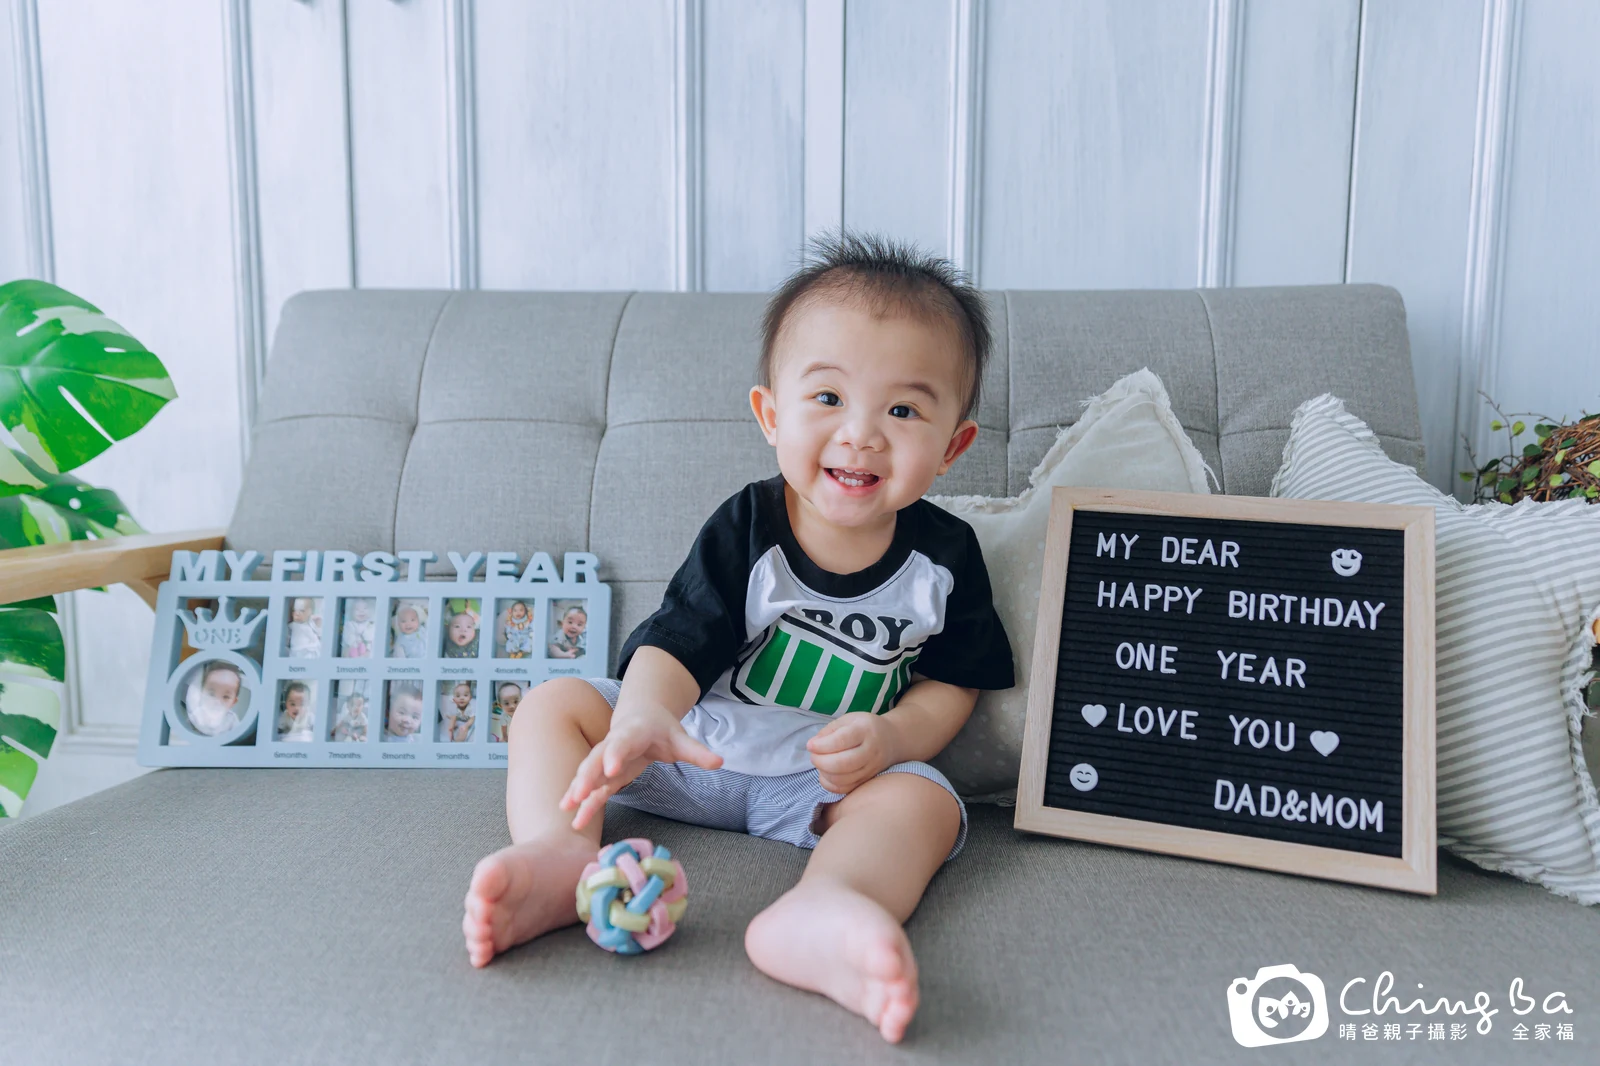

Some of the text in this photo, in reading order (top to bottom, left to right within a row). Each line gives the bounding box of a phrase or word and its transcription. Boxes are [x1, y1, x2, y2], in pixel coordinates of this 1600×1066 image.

[168, 549, 600, 583] MY FIRST YEAR
[1096, 532, 1241, 568] MY DEAR
[1097, 580, 1386, 631] HAPPY BIRTHDAY
[194, 627, 243, 644] ONE
[1115, 642, 1307, 689] ONE YEAR
[1117, 702, 1295, 752] LOVE YOU
[1213, 779, 1384, 833] DAD&MOM
